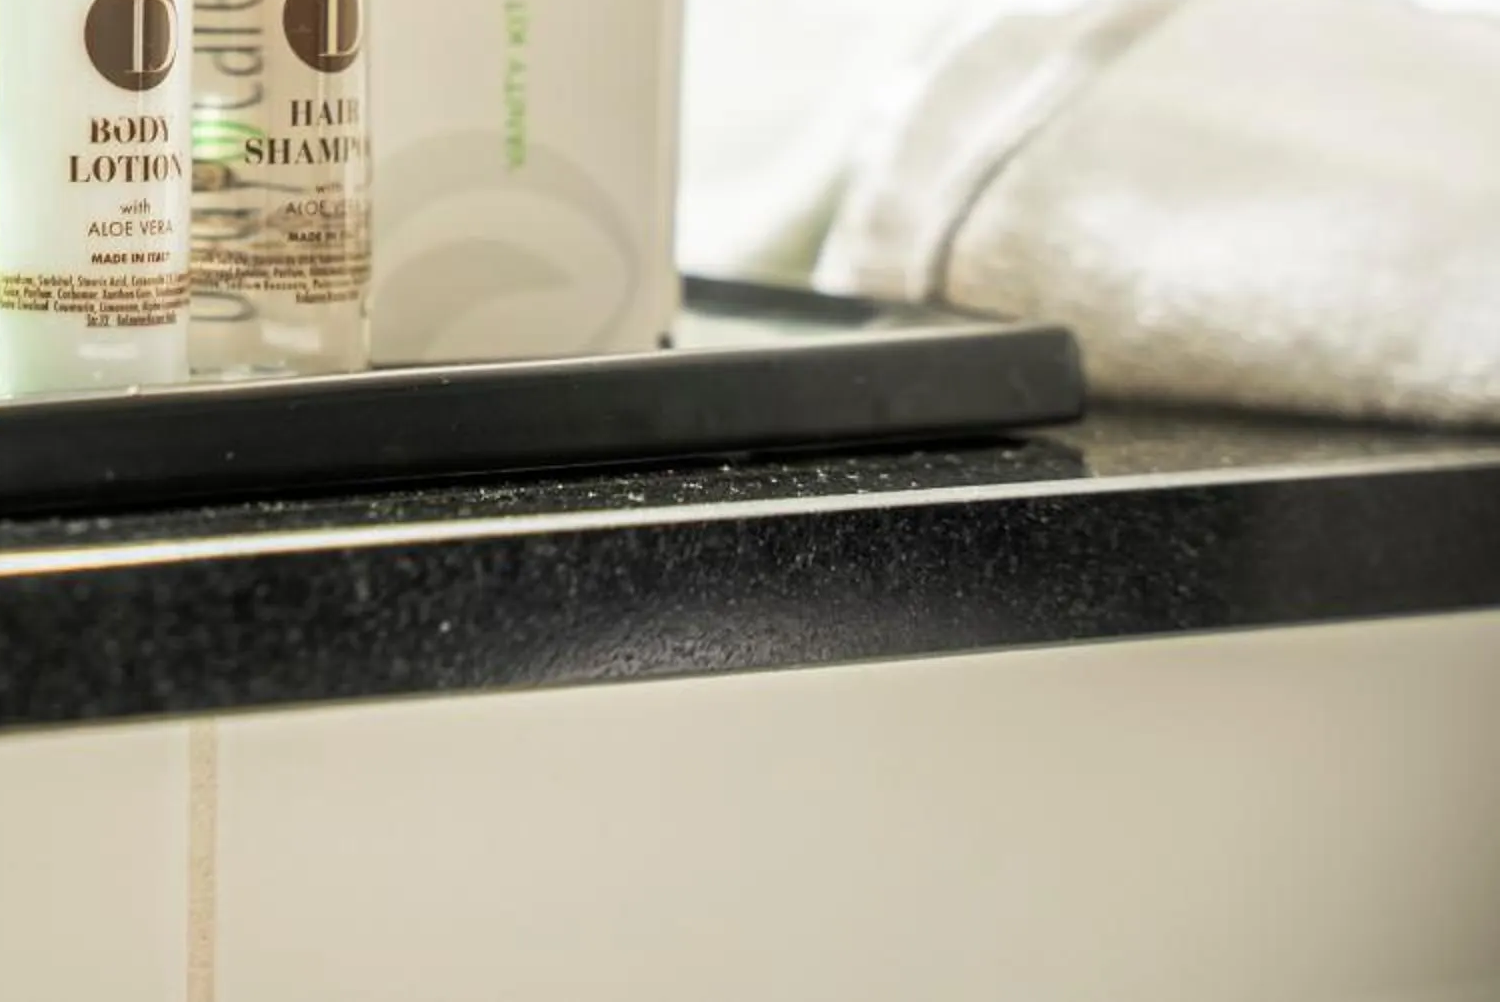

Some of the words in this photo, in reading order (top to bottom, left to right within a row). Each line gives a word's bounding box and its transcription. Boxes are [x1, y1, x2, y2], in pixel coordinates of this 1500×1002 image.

[291, 99, 361, 127] HAIR
[89, 115, 169, 144] BODY
[69, 153, 182, 183] LOTION
[120, 197, 151, 215] with
[87, 221, 133, 237] ALOE
[139, 219, 174, 236] VERA
[91, 253, 127, 265] MADE
[131, 253, 145, 264] IN
